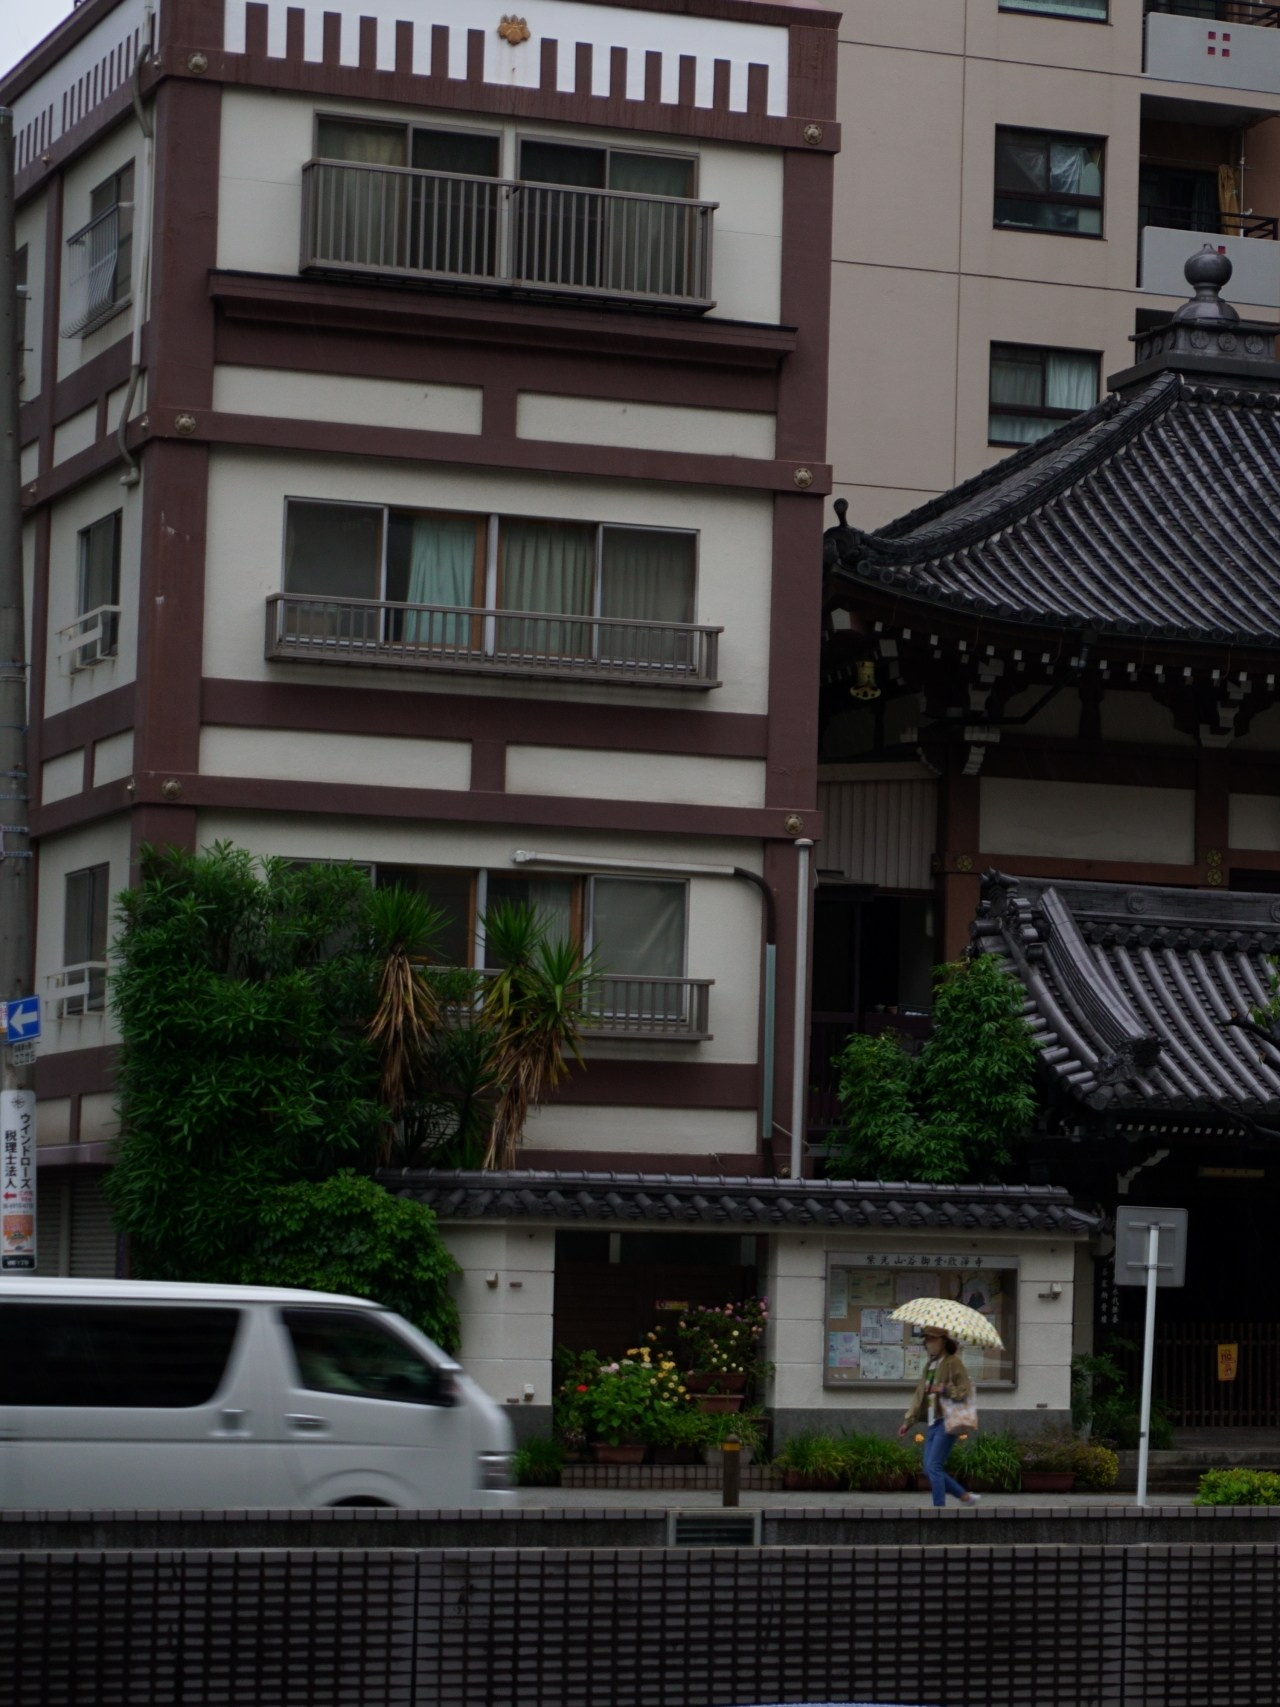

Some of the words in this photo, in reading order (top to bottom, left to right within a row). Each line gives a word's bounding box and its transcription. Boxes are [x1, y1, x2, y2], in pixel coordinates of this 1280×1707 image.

[5, 1130, 17, 1189] 税理士法人
[20, 1113, 31, 1189] ウインドローズ
